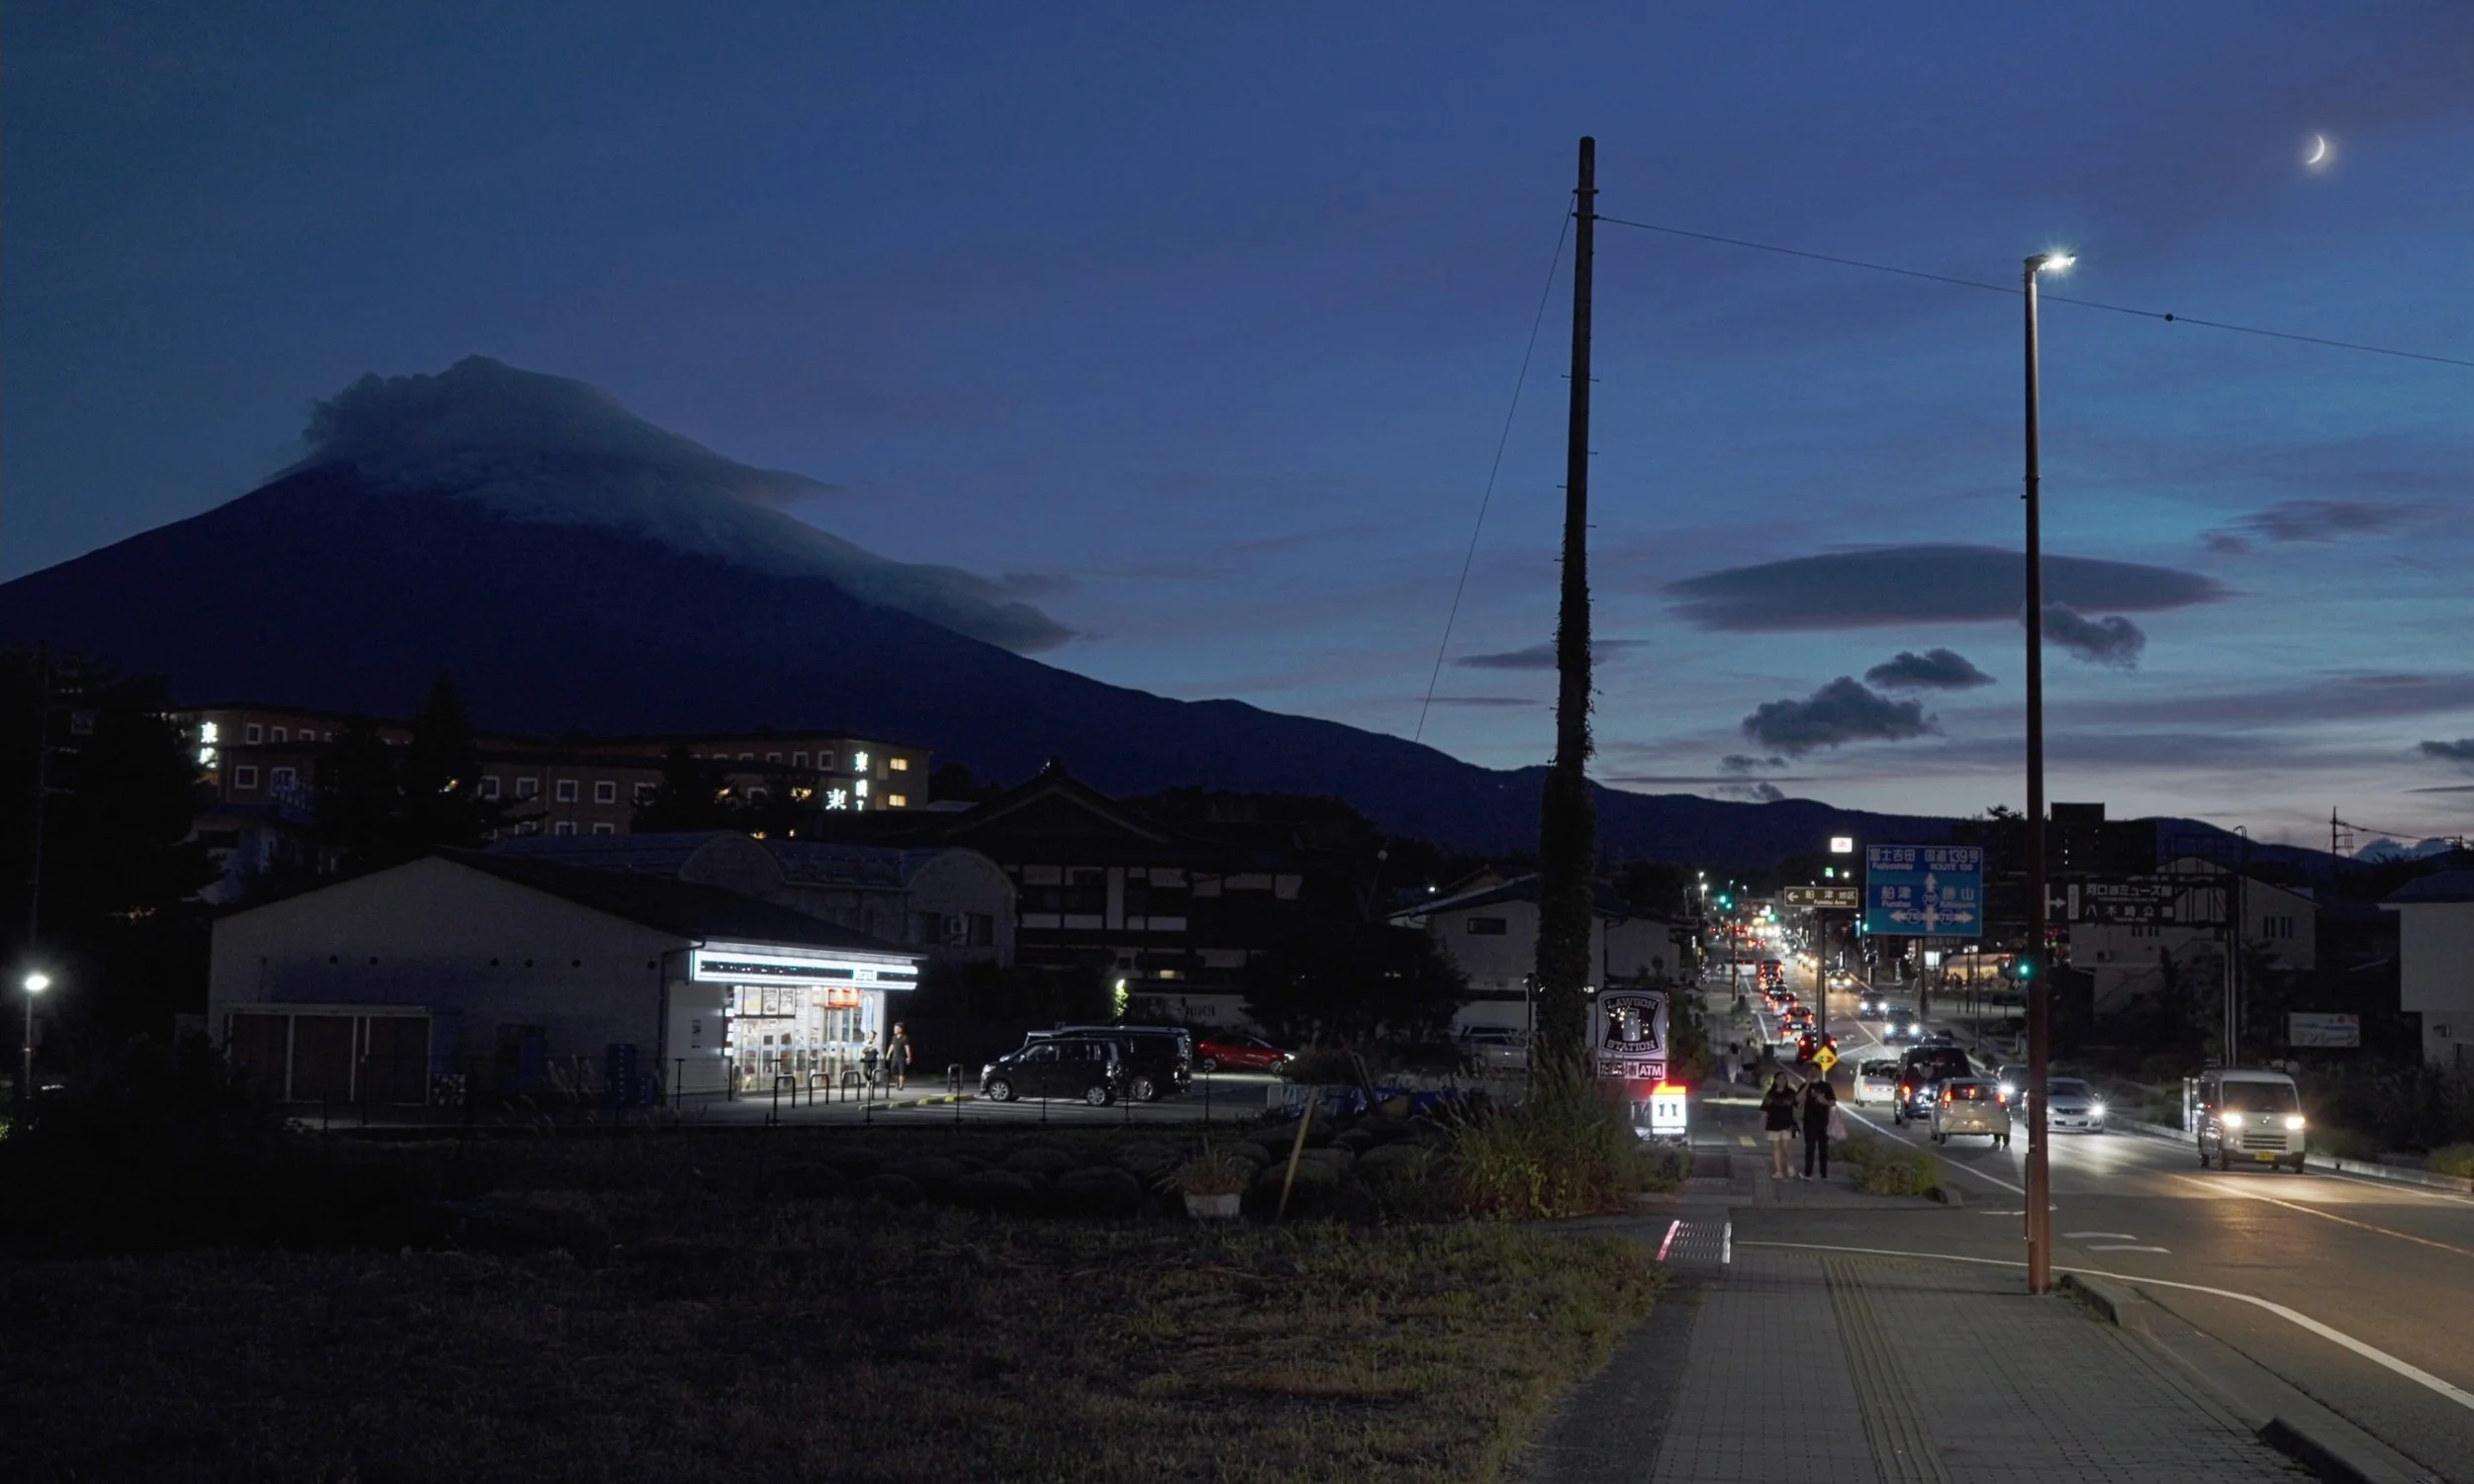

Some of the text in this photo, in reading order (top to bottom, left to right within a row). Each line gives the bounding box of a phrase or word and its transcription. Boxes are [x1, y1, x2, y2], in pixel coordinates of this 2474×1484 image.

[1870, 848, 1978, 864] 富士吉田 国道139号
[1930, 863, 1956, 872] ROUTE
[1881, 886, 1911, 900] 船津
[1606, 997, 1658, 1009] LAWSON
[1606, 1039, 1656, 1052] STATION
[1639, 1065, 1663, 1076] ATM
